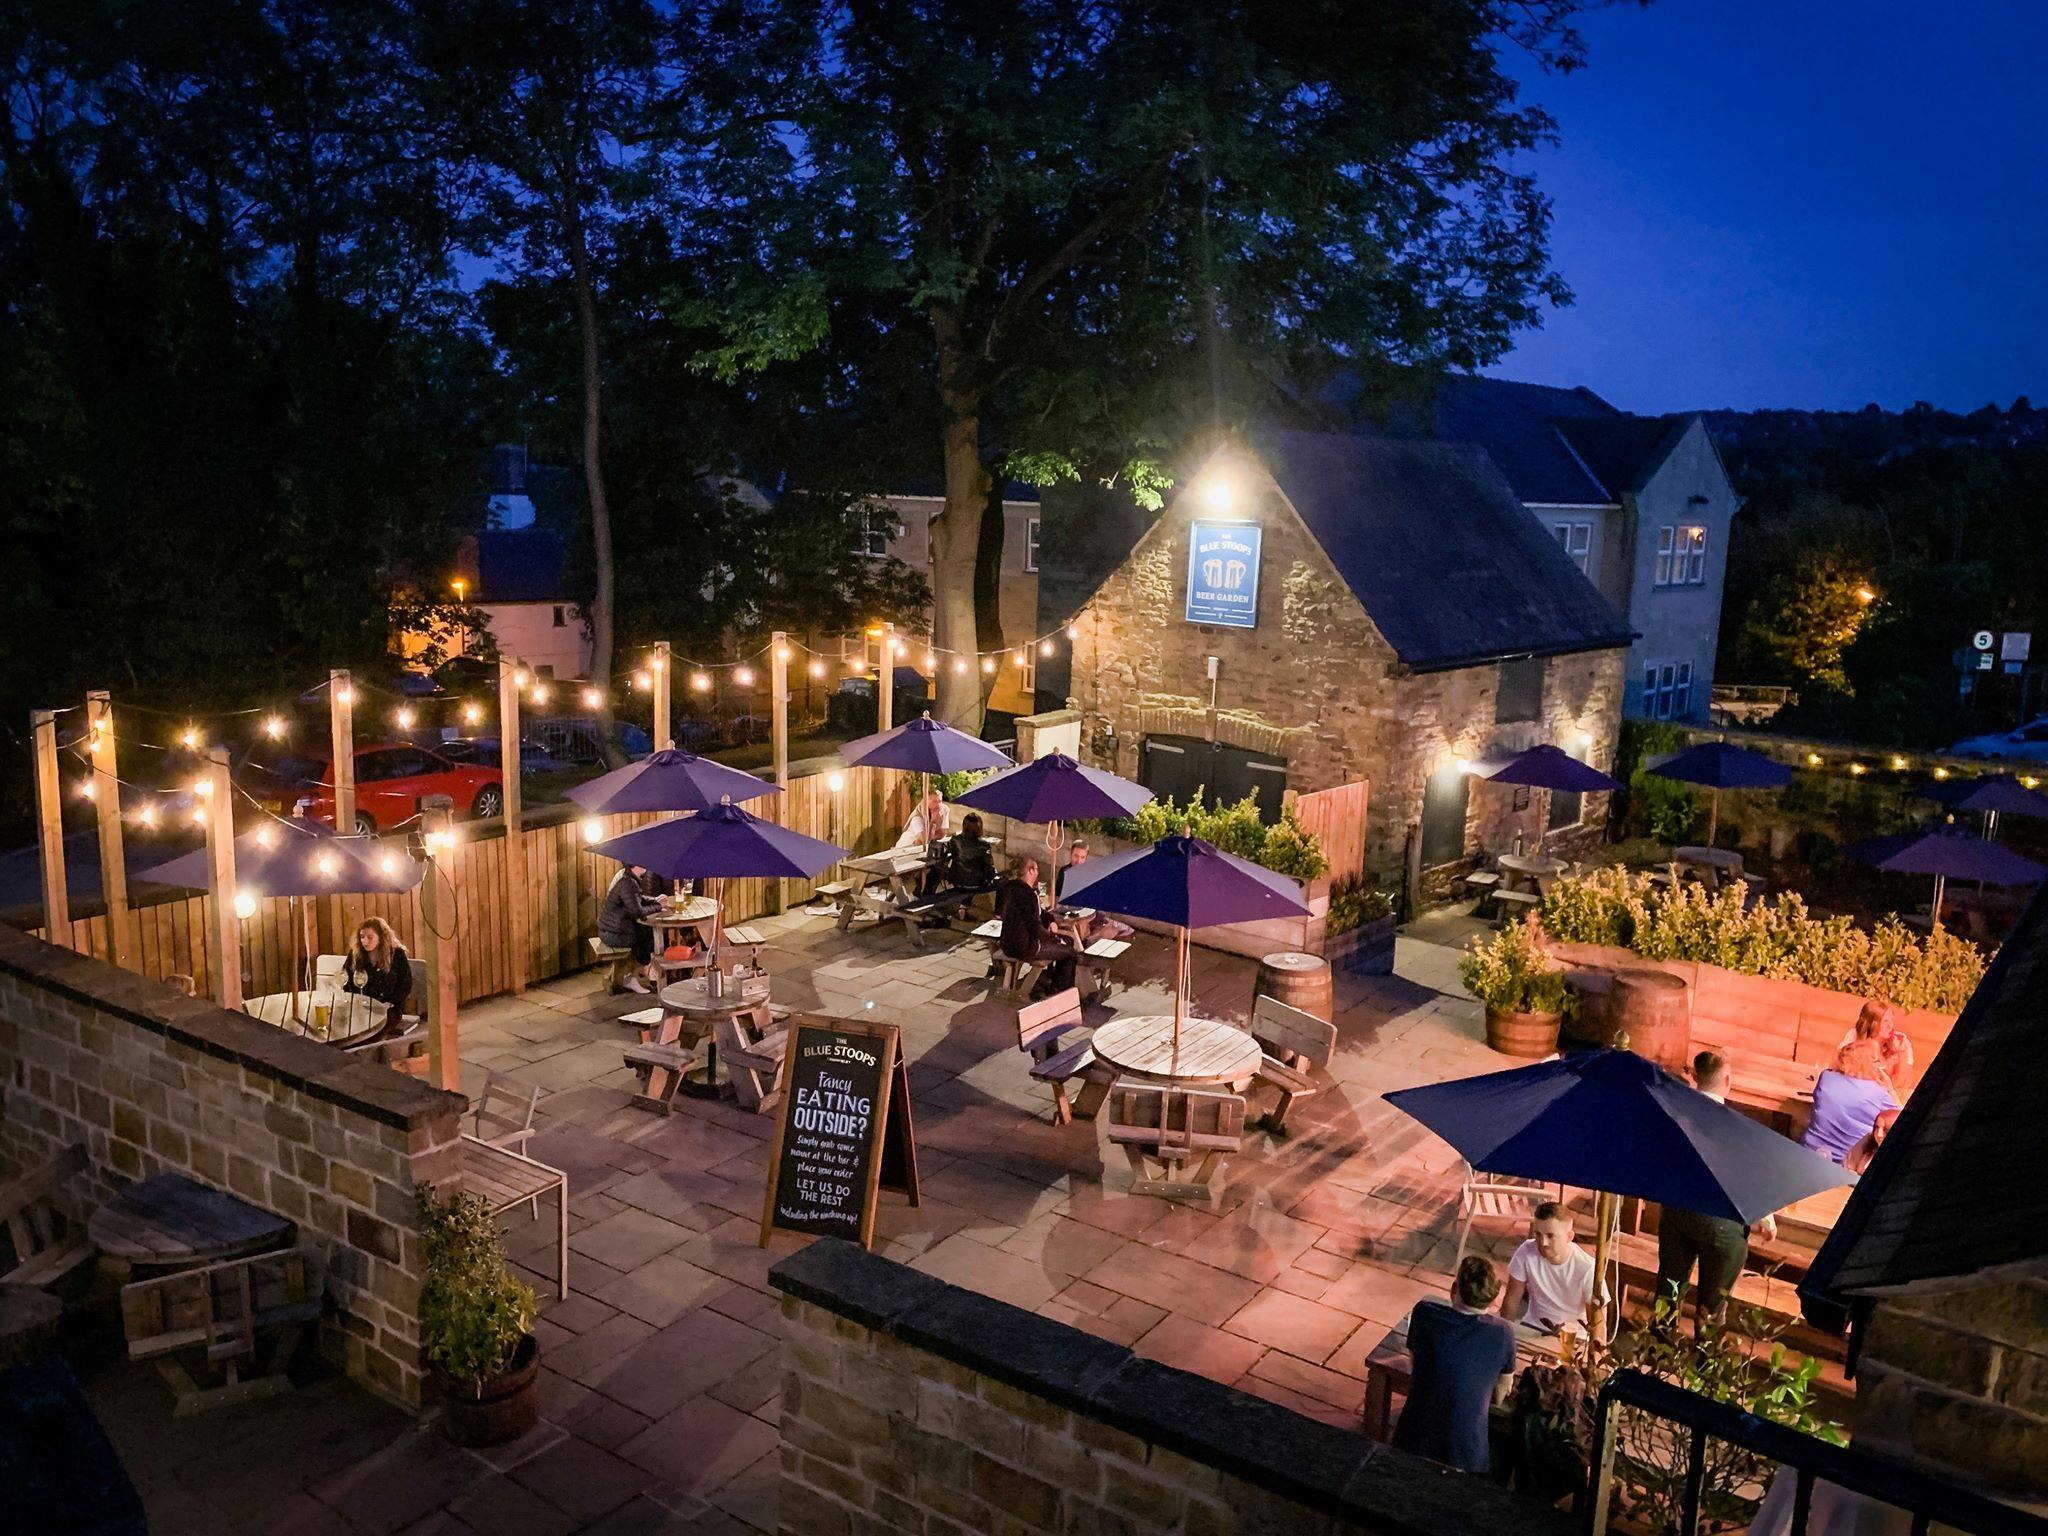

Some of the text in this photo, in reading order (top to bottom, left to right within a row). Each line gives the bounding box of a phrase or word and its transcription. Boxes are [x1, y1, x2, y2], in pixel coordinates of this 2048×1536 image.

[1200, 541, 1252, 555] BLUE STOOPS
[1196, 591, 1249, 603] BEER GARDEN
[1979, 635, 1987, 646] 5
[804, 1045, 832, 1057] BLUE
[834, 1046, 876, 1066] STOOPS
[818, 1071, 852, 1094] Fancy
[797, 1088, 870, 1115] EATING
[794, 1107, 867, 1138] OUTSIDE?
[797, 1135, 819, 1148] Simply
[837, 1142, 855, 1153] some
[812, 1152, 820, 1160] at
[823, 1152, 836, 1163] the
[838, 1155, 850, 1165] bar
[853, 1155, 860, 1167] &
[797, 1162, 816, 1173] place
[834, 1169, 854, 1178] order
[796, 1178, 850, 1196] LET US DO
[800, 1190, 843, 1206] THE REST
[809, 1210, 820, 1219] the
